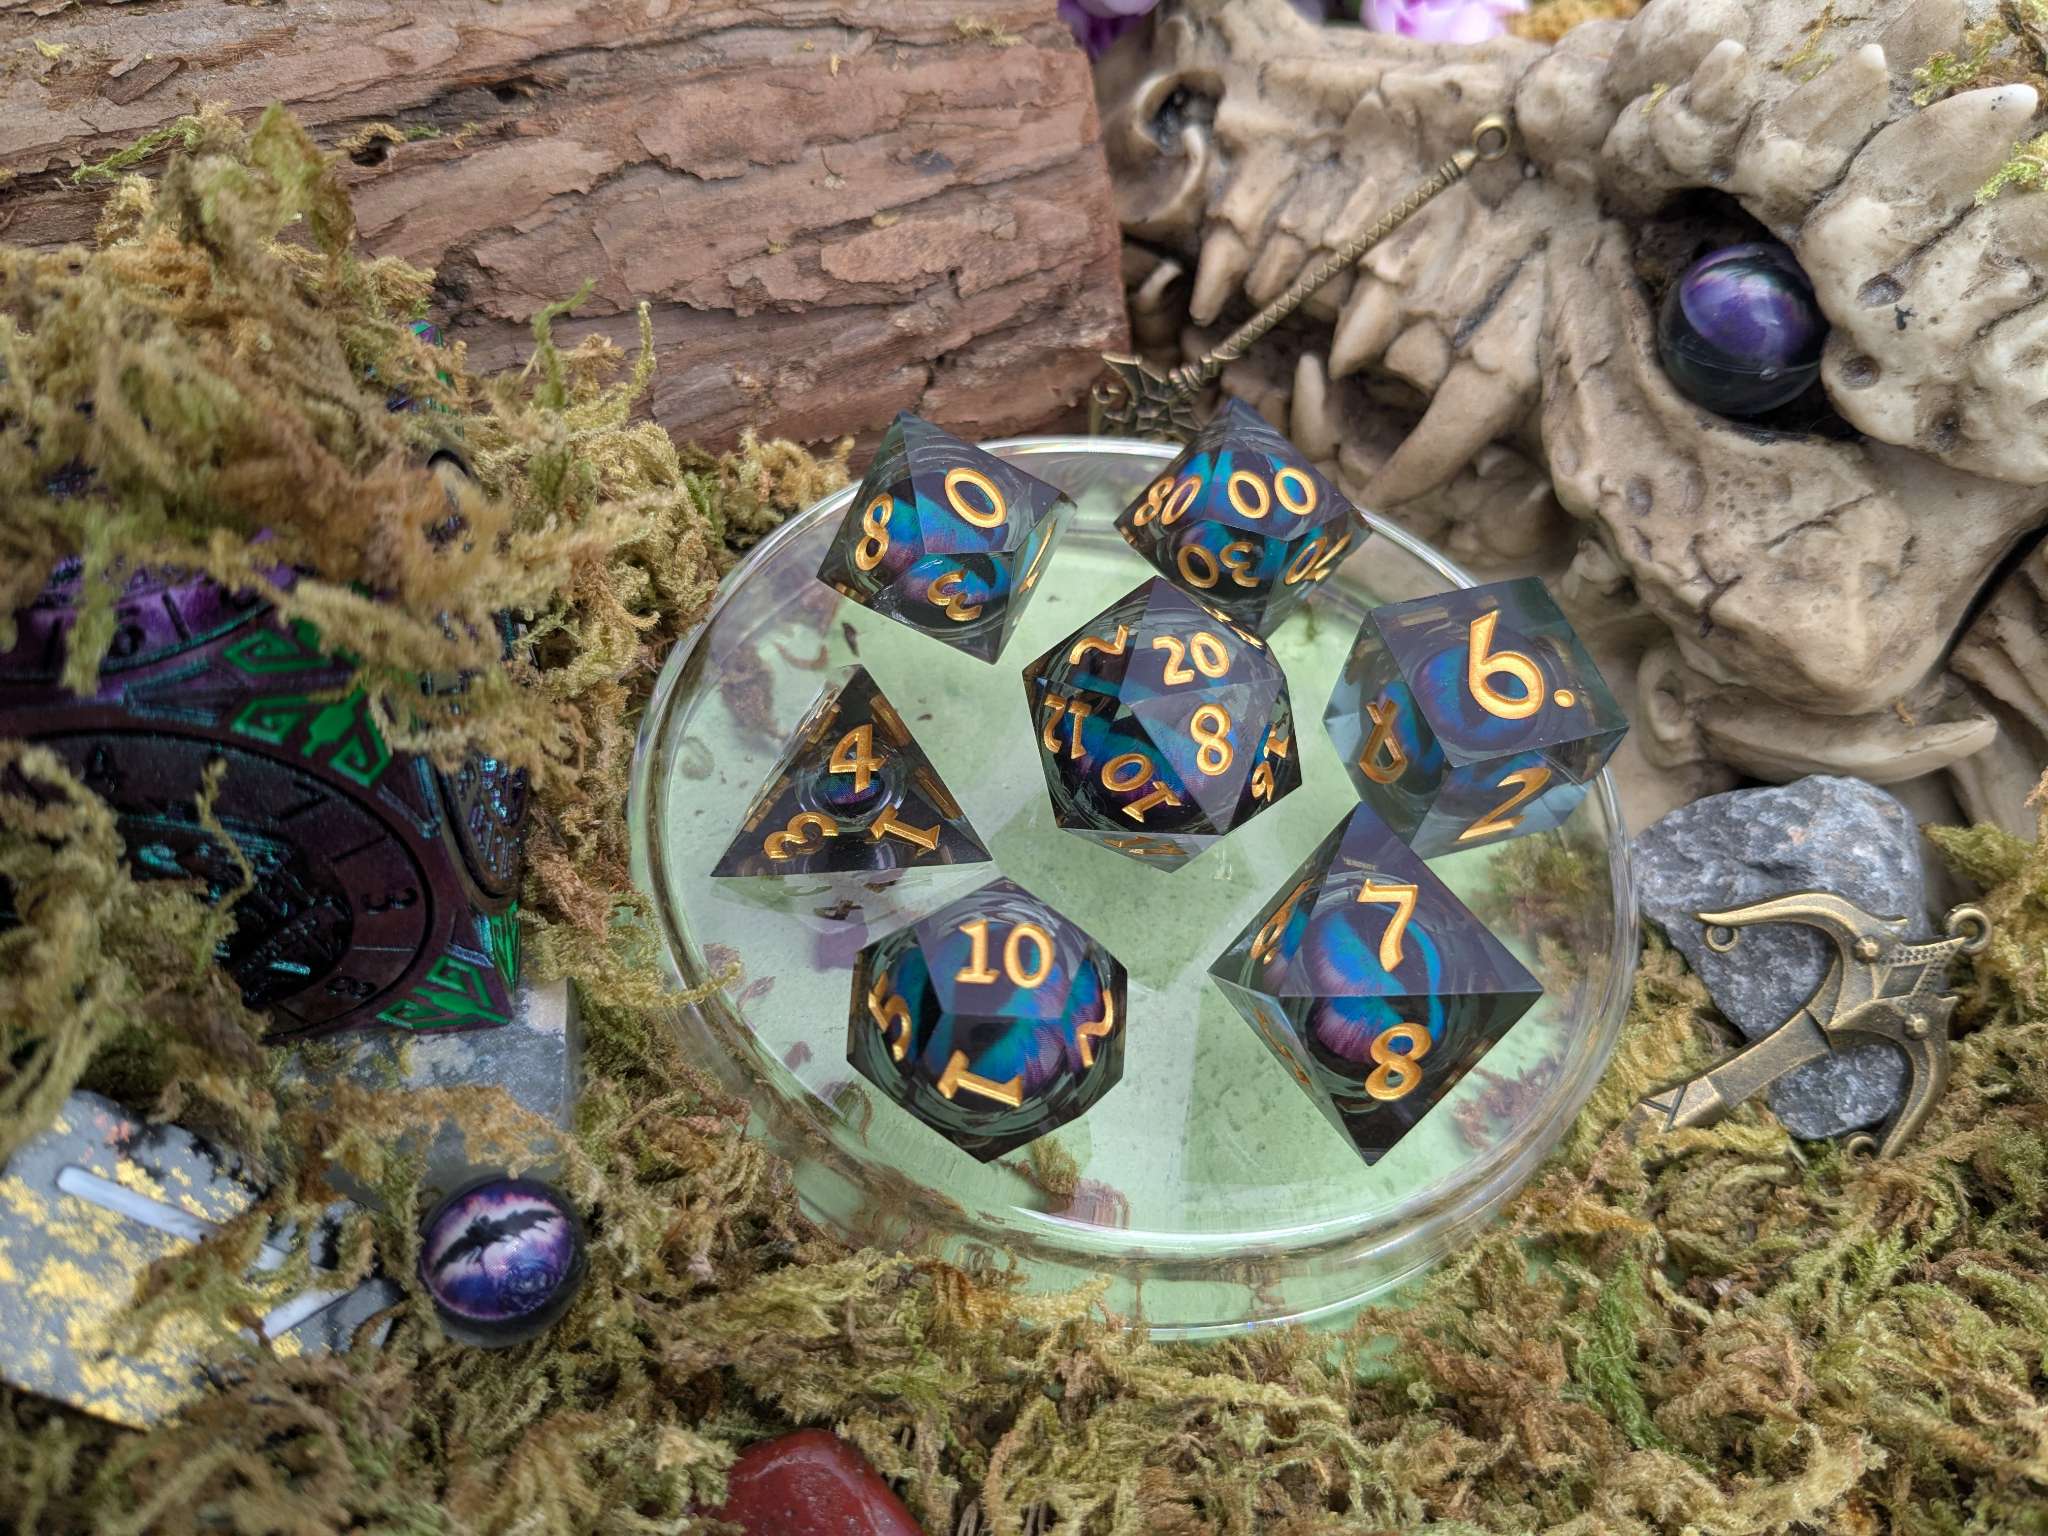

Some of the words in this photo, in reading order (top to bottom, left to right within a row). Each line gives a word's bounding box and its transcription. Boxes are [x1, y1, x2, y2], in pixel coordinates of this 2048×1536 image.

[945, 467, 1007, 529] 0
[1133, 476, 1202, 526] 80
[1227, 467, 1317, 519] 00
[855, 491, 894, 571] 8
[928, 570, 983, 622] 3
[1177, 541, 1262, 589] 30
[1069, 624, 1130, 666] 2
[1152, 631, 1231, 687] 20
[829, 724, 889, 794] 4
[1044, 694, 1094, 760] 12
[1190, 703, 1234, 777] 8
[1359, 700, 1408, 785] 4
[1101, 752, 1182, 824] 10
[1456, 767, 1552, 841] 2
[764, 811, 840, 862] 3
[870, 804, 942, 851] 1
[955, 919, 1056, 989] 10
[1356, 879, 1419, 973] 7
[937, 1050, 1024, 1108] 1
[1365, 1022, 1432, 1101] 8
